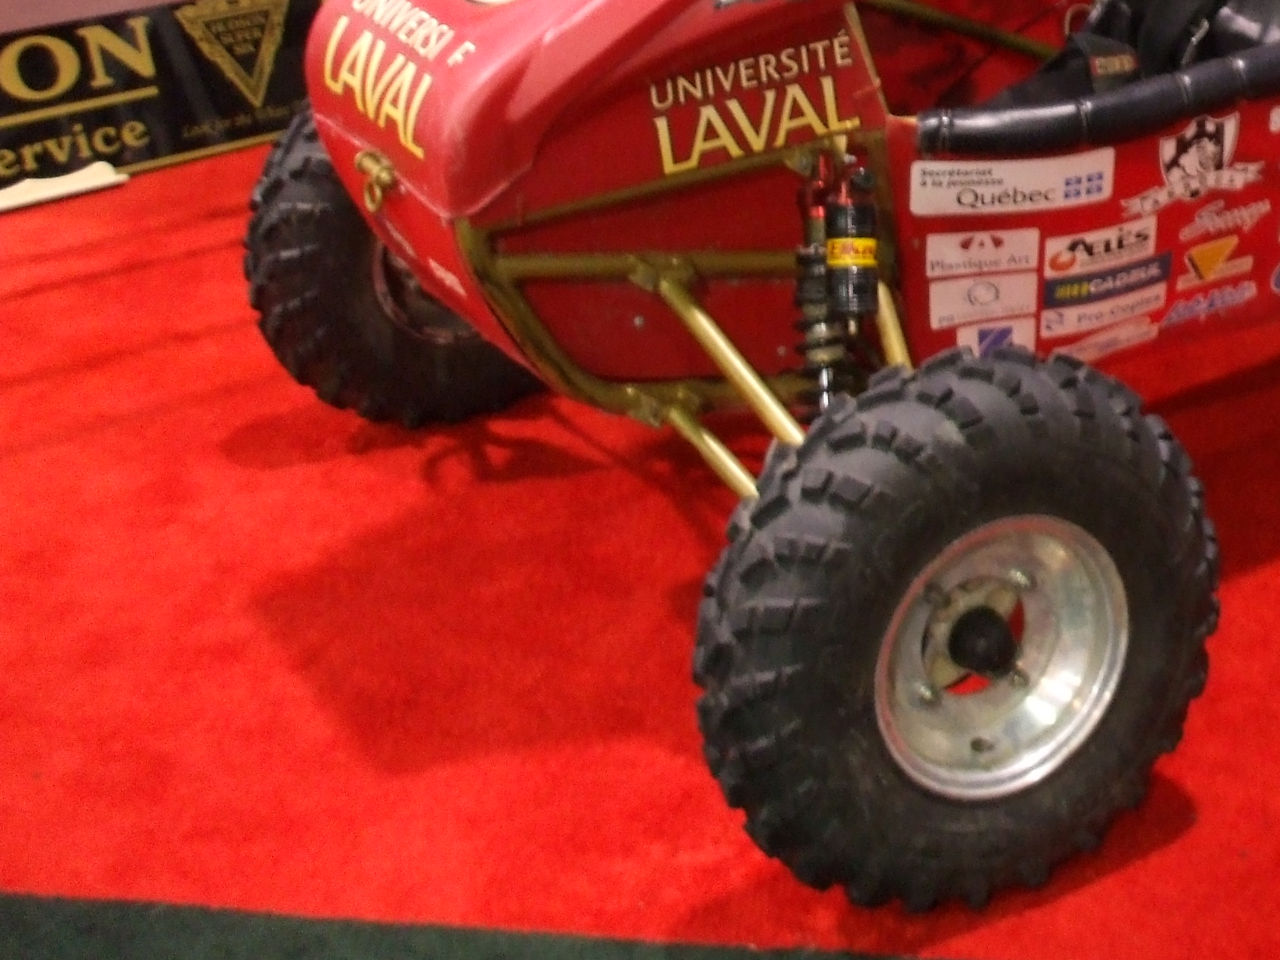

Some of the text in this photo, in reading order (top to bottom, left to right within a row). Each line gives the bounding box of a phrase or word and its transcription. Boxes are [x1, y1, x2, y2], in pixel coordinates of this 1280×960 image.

[324, 15, 433, 159] LAVAL
[650, 28, 853, 111] UNIVERSITÉ
[653, 75, 861, 175] LAVAL
[956, 187, 1056, 208] Québec
